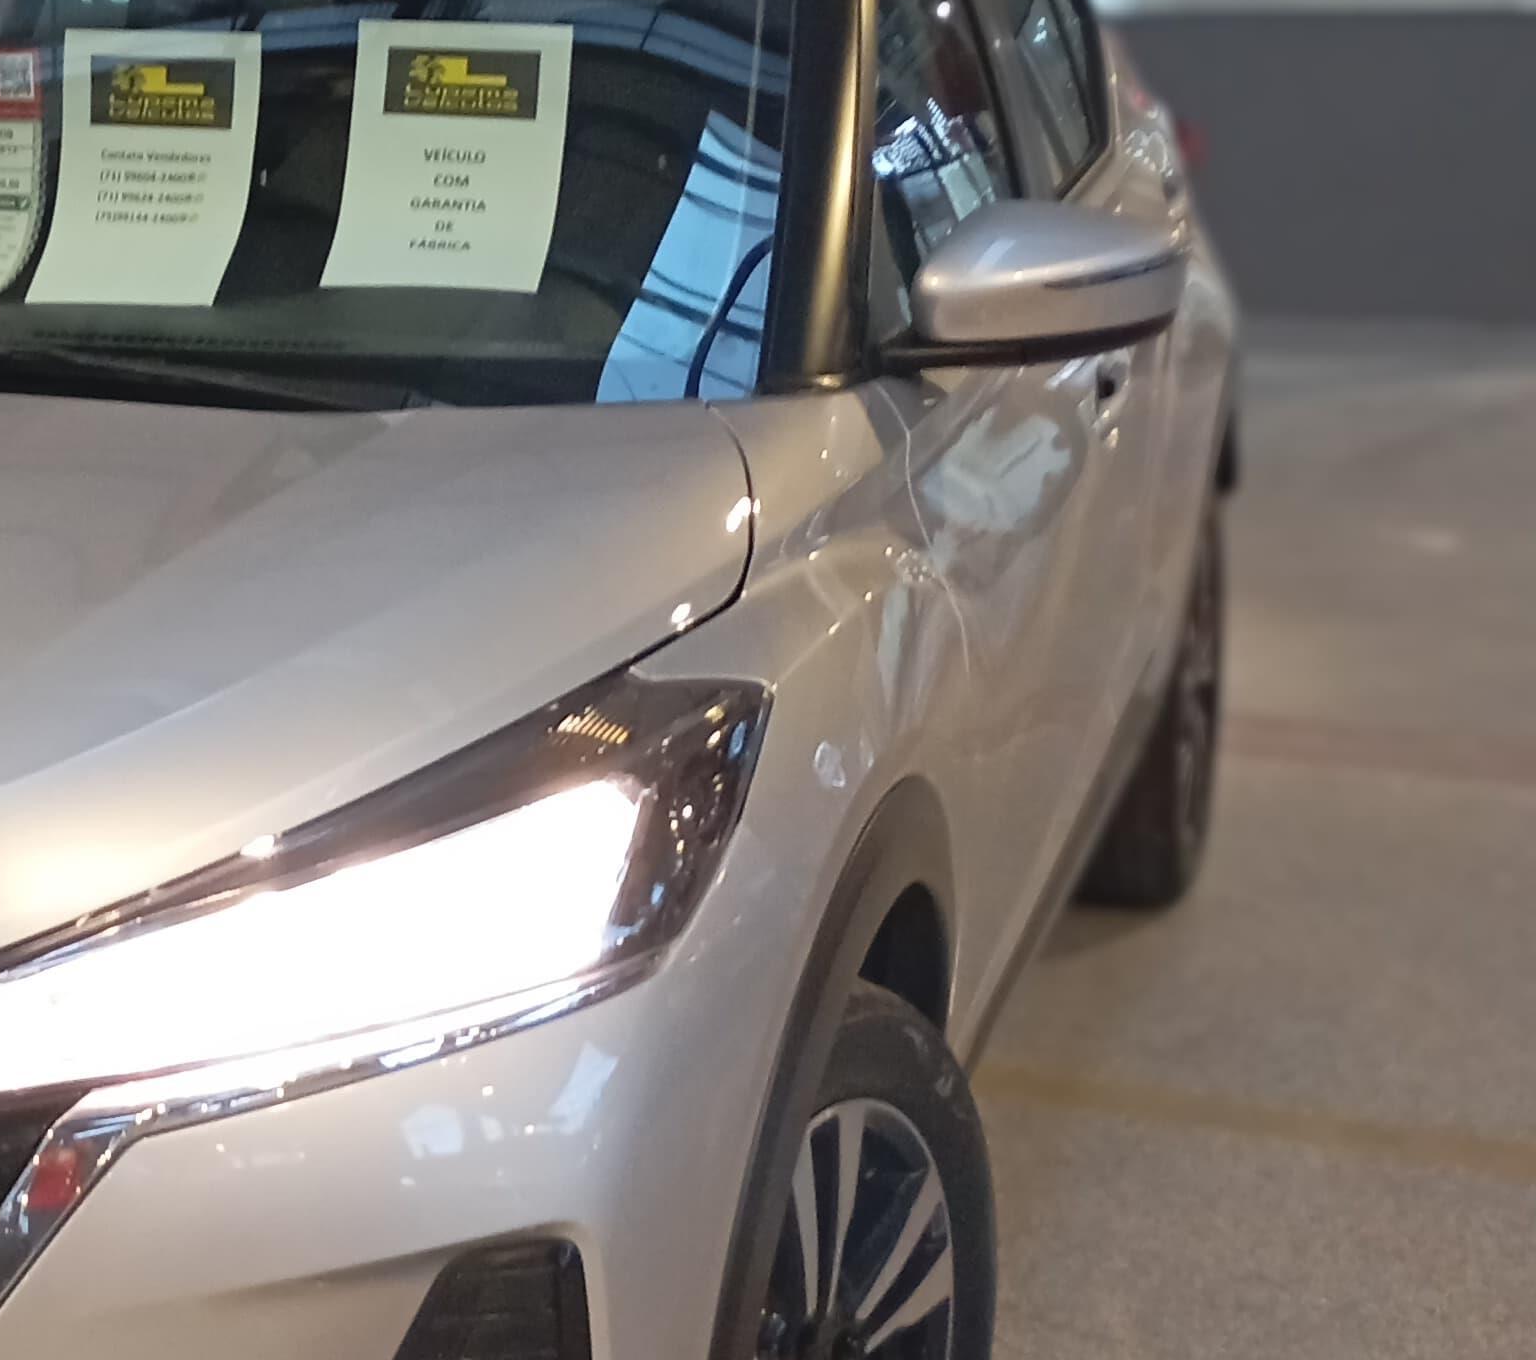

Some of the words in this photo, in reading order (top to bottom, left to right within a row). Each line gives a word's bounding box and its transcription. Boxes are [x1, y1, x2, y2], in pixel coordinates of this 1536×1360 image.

[424, 147, 486, 165] VEÍCULO
[433, 174, 470, 189] COM
[410, 196, 487, 213] GARANTIA
[434, 219, 454, 233] DE
